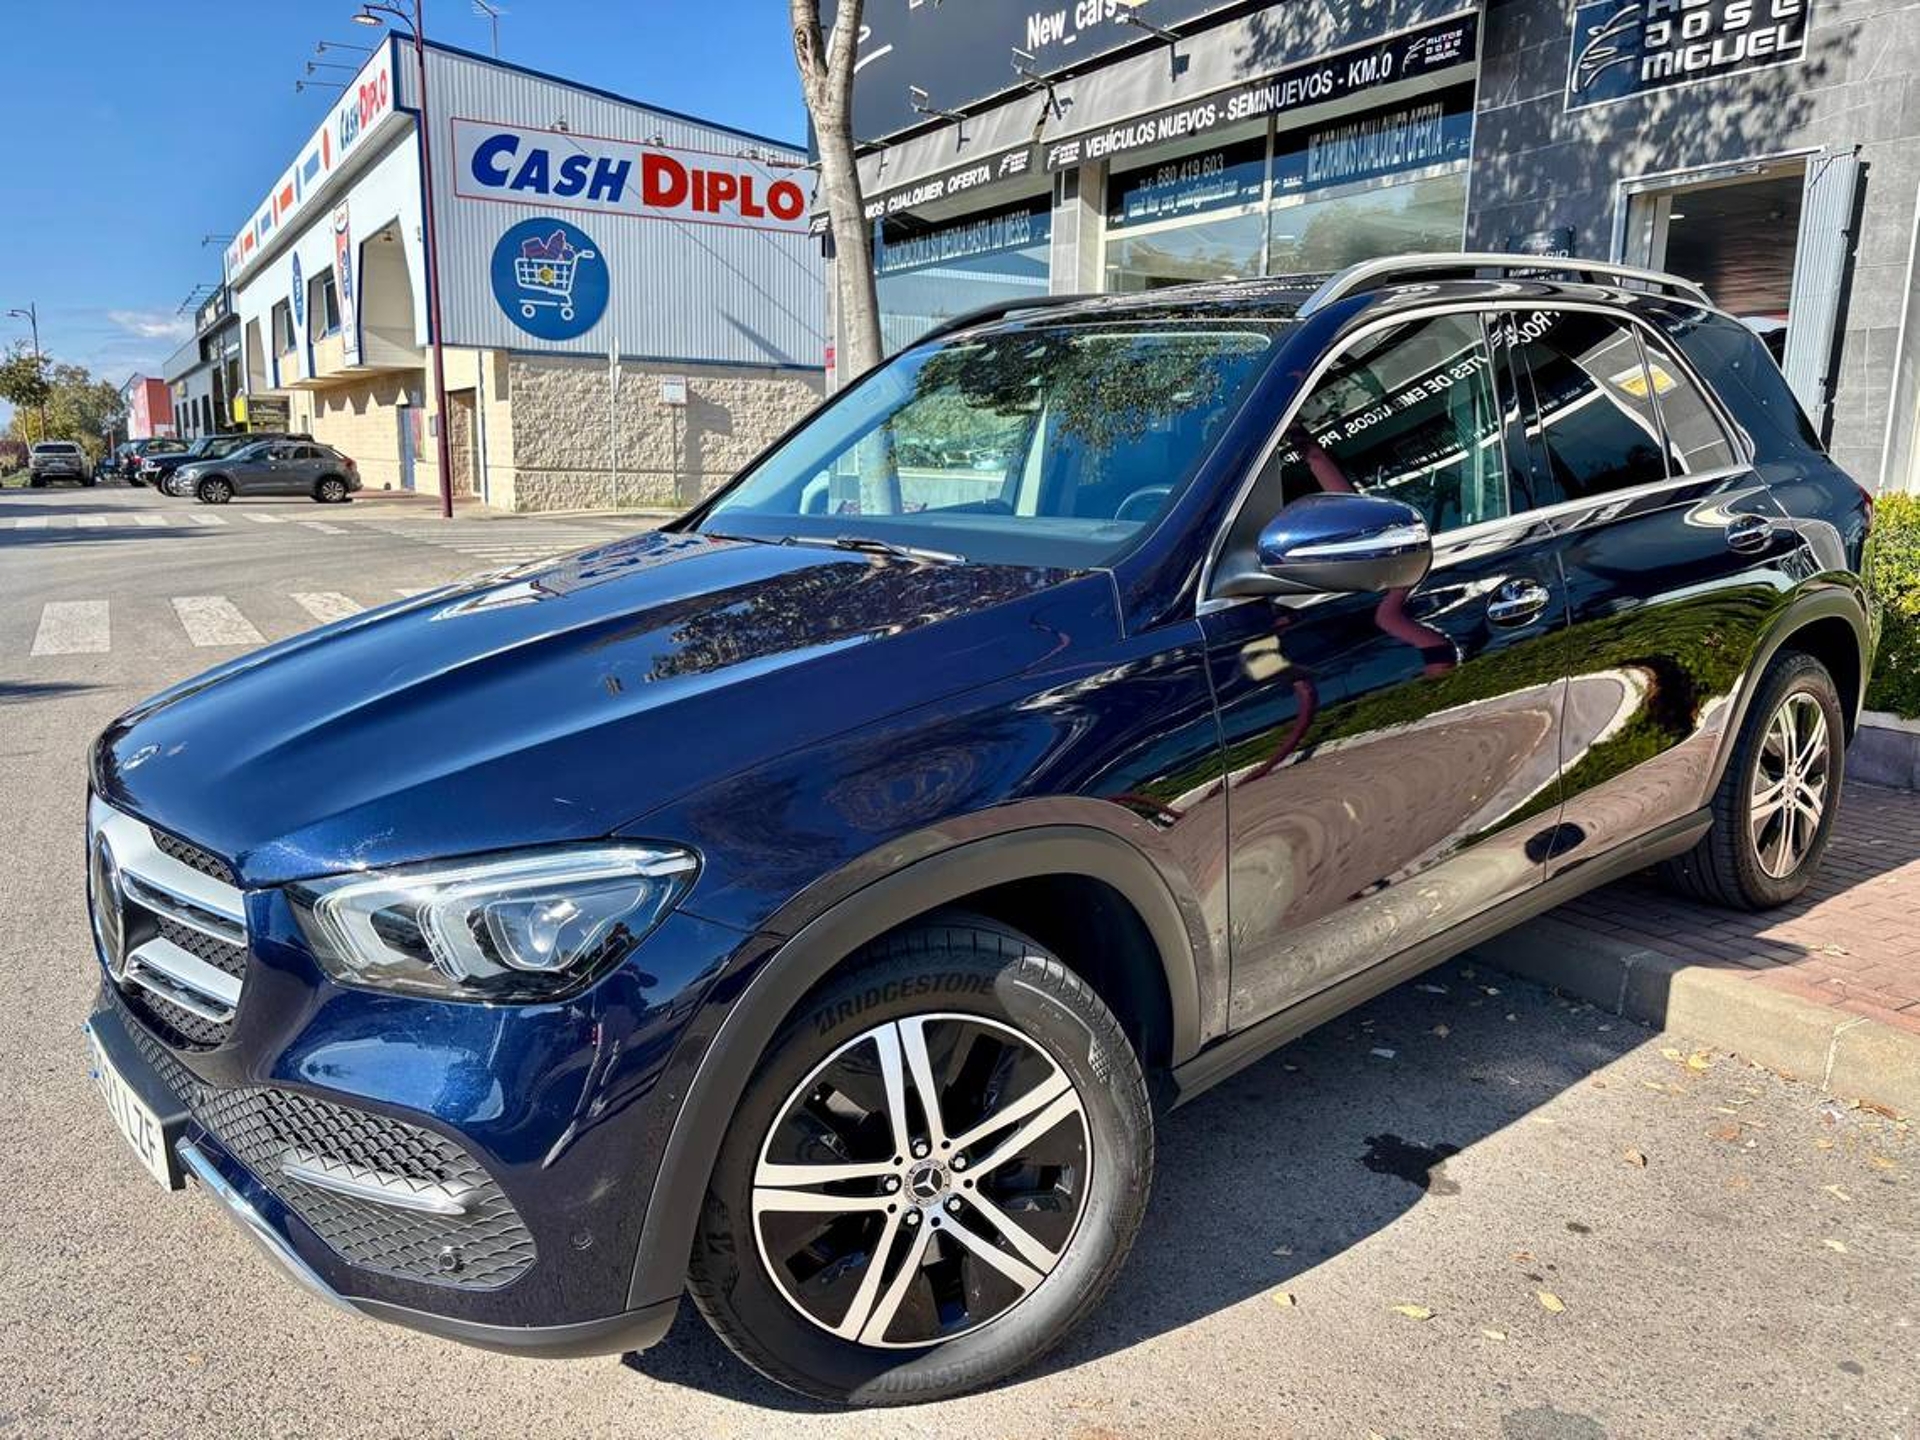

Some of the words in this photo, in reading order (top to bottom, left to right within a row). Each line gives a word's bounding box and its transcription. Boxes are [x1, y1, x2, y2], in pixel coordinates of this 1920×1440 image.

[1641, 24, 1803, 81] MIGUEL
[359, 69, 387, 129] DIPLO
[1085, 123, 1157, 158] VEHÍCULOS
[1158, 103, 1217, 140] NUEVOS
[1227, 69, 1333, 121] SEMINUEVOS
[1348, 52, 1393, 88] KM.0
[471, 134, 632, 203] CASH
[642, 152, 805, 221] DIPLO
[887, 181, 944, 213] CUALQUIER
[947, 165, 990, 194] OFERTA
[1179, 159, 1200, 182] 419
[1203, 153, 1224, 178] 603
